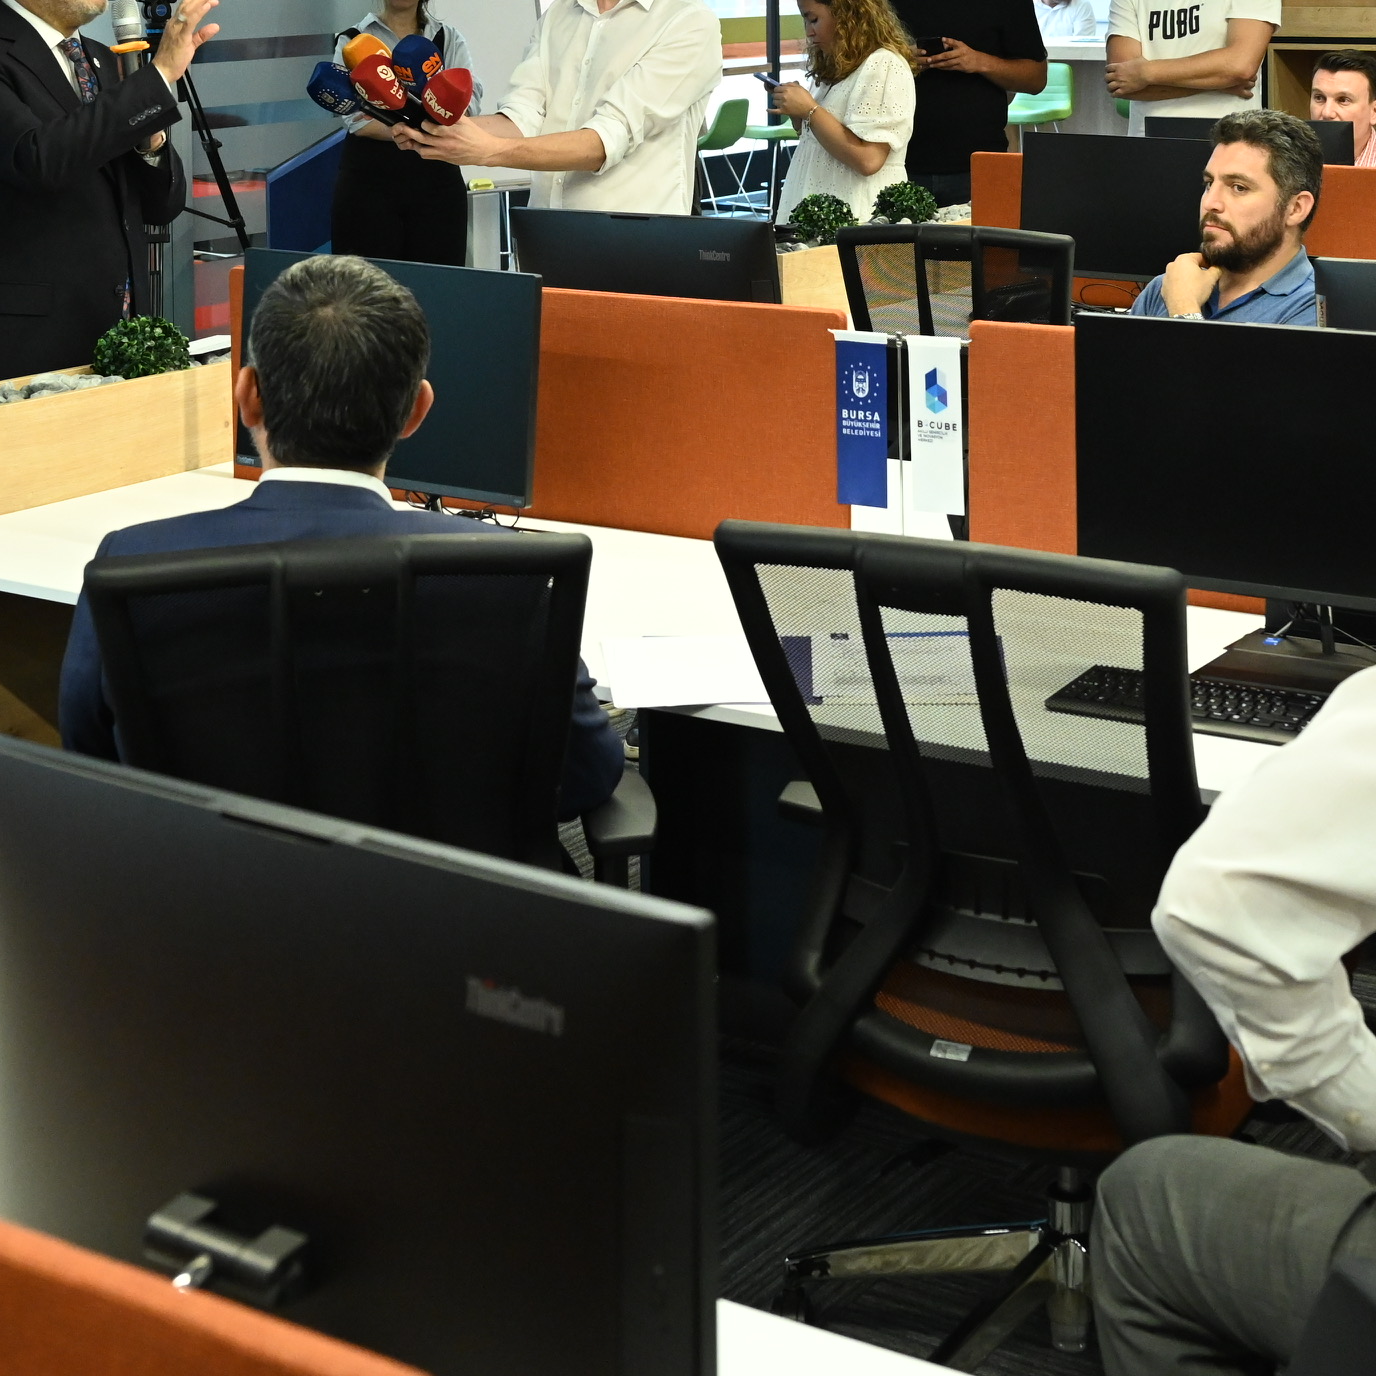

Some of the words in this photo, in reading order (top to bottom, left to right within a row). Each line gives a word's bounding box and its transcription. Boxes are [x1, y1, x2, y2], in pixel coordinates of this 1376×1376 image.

[1149, 4, 1200, 41] PUBG
[424, 91, 453, 119] HAYAT
[842, 409, 880, 421] BURSA
